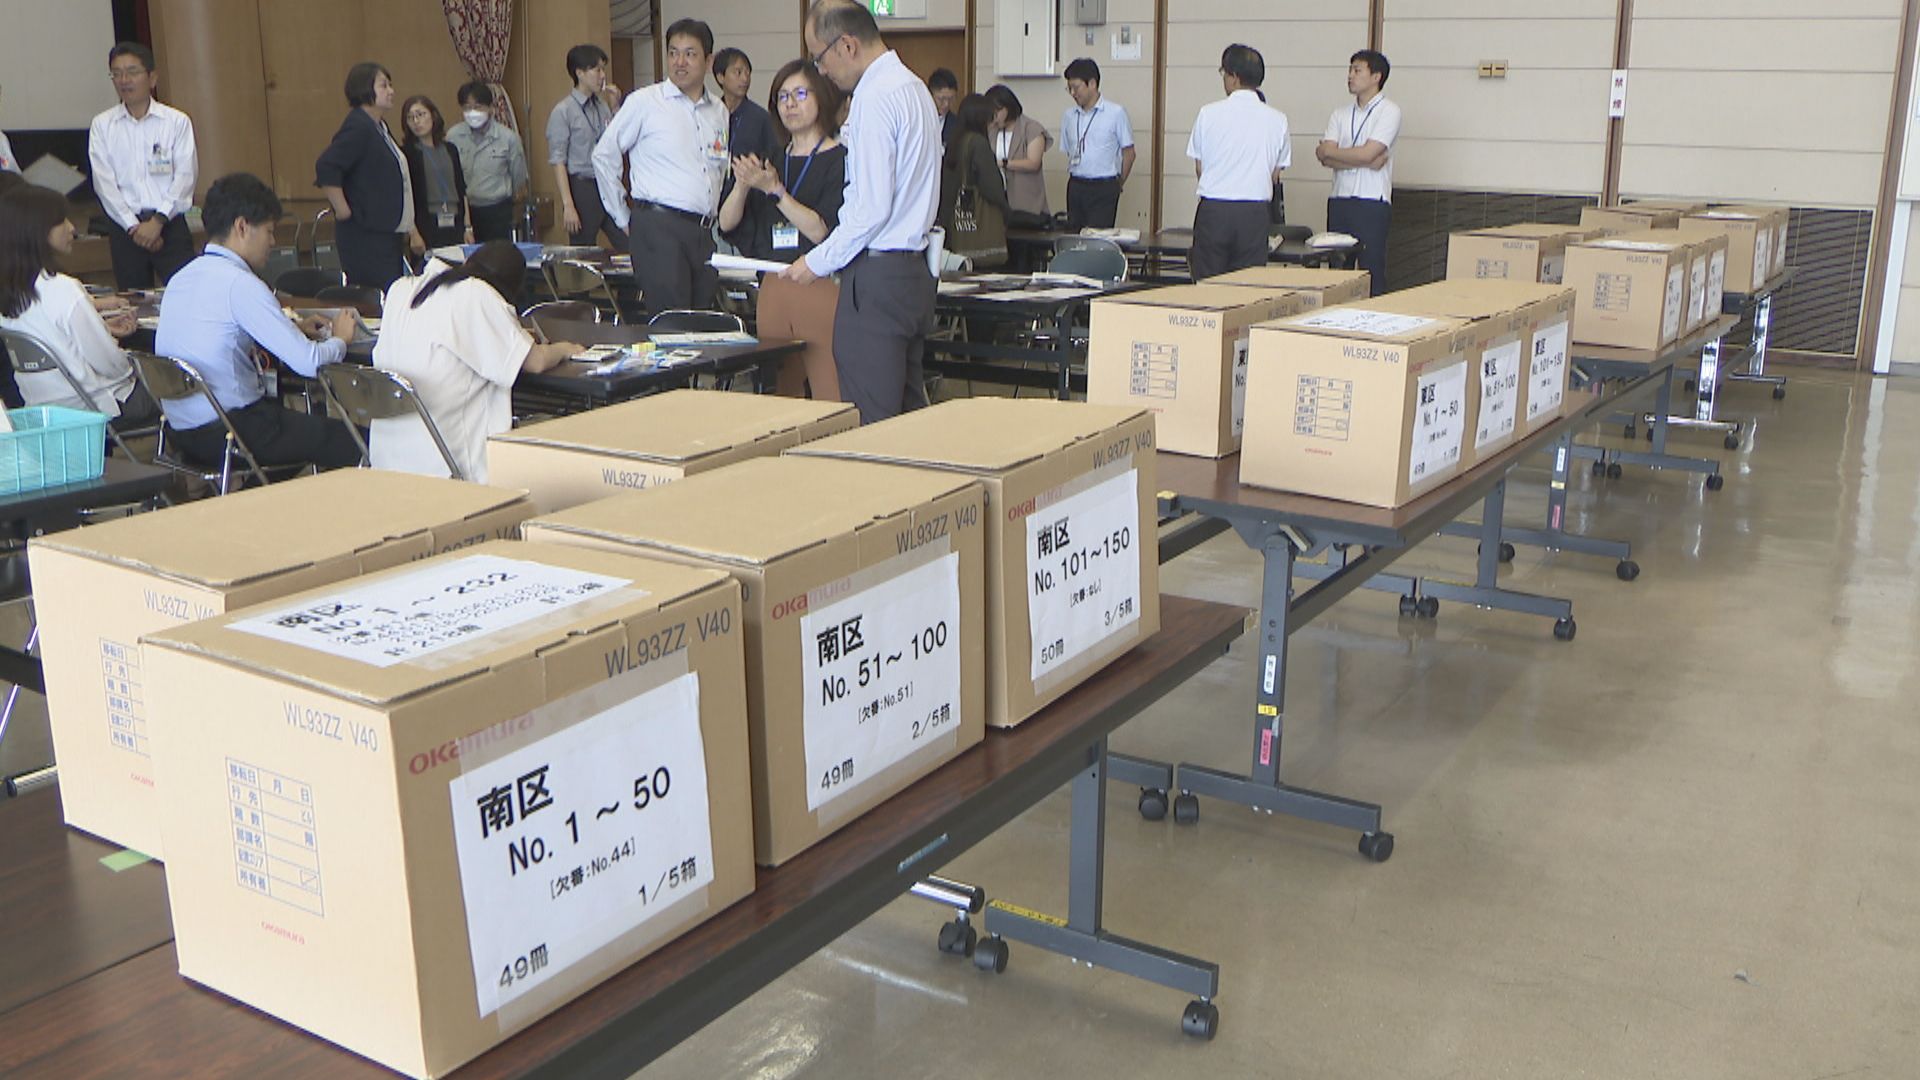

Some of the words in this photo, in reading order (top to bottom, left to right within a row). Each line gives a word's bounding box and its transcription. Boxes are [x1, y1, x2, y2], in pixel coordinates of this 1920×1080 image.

[1202, 317, 1216, 329] V40
[1383, 350, 1400, 363] V40
[1135, 429, 1153, 452] V40
[602, 467, 647, 491] WL93ZZ
[896, 513, 949, 554] WL93ZZ
[955, 504, 978, 531] V40
[1037, 516, 1071, 560] 南区
[1035, 569, 1056, 596] No.
[144, 588, 190, 620] WL93ZZ
[605, 623, 687, 678] WL93ZZ
[697, 607, 731, 642] V40
[816, 613, 865, 668] 南区
[822, 675, 851, 707] No.
[283, 701, 343, 741] WL93ZZ
[349, 721, 379, 753] V40
[477, 764, 554, 839] 南区
[508, 836, 554, 877] No.
[565, 811, 580, 844] 1
[634, 766, 672, 810] 50
